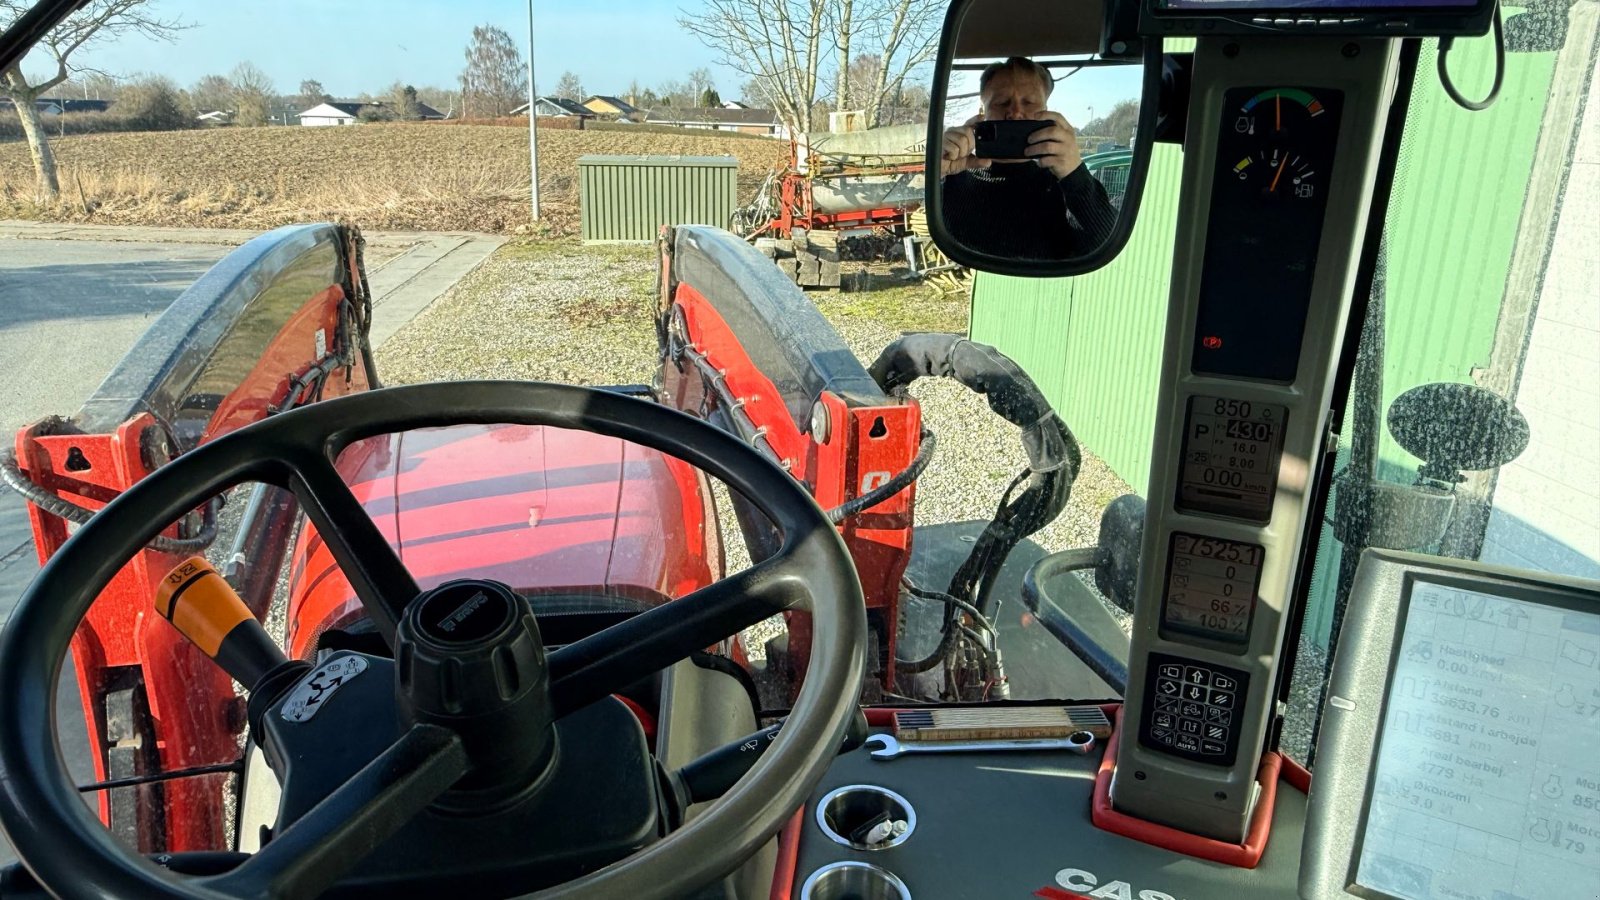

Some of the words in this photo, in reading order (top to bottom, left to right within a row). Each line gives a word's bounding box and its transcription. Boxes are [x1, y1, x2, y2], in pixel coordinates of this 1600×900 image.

[1214, 398, 1251, 418] 850
[1195, 424, 1209, 439] P
[1232, 442, 1257, 455] 16.0
[1229, 457, 1255, 469] 8.00
[1203, 467, 1242, 487] 0.00
[1225, 566, 1236, 580] 0
[1223, 583, 1233, 597] 0
[1211, 599, 1231, 613] 66
[1437, 659, 1468, 674] 0.00
[1177, 742, 1197, 751] AUTO
[1565, 838, 1585, 854] 79
